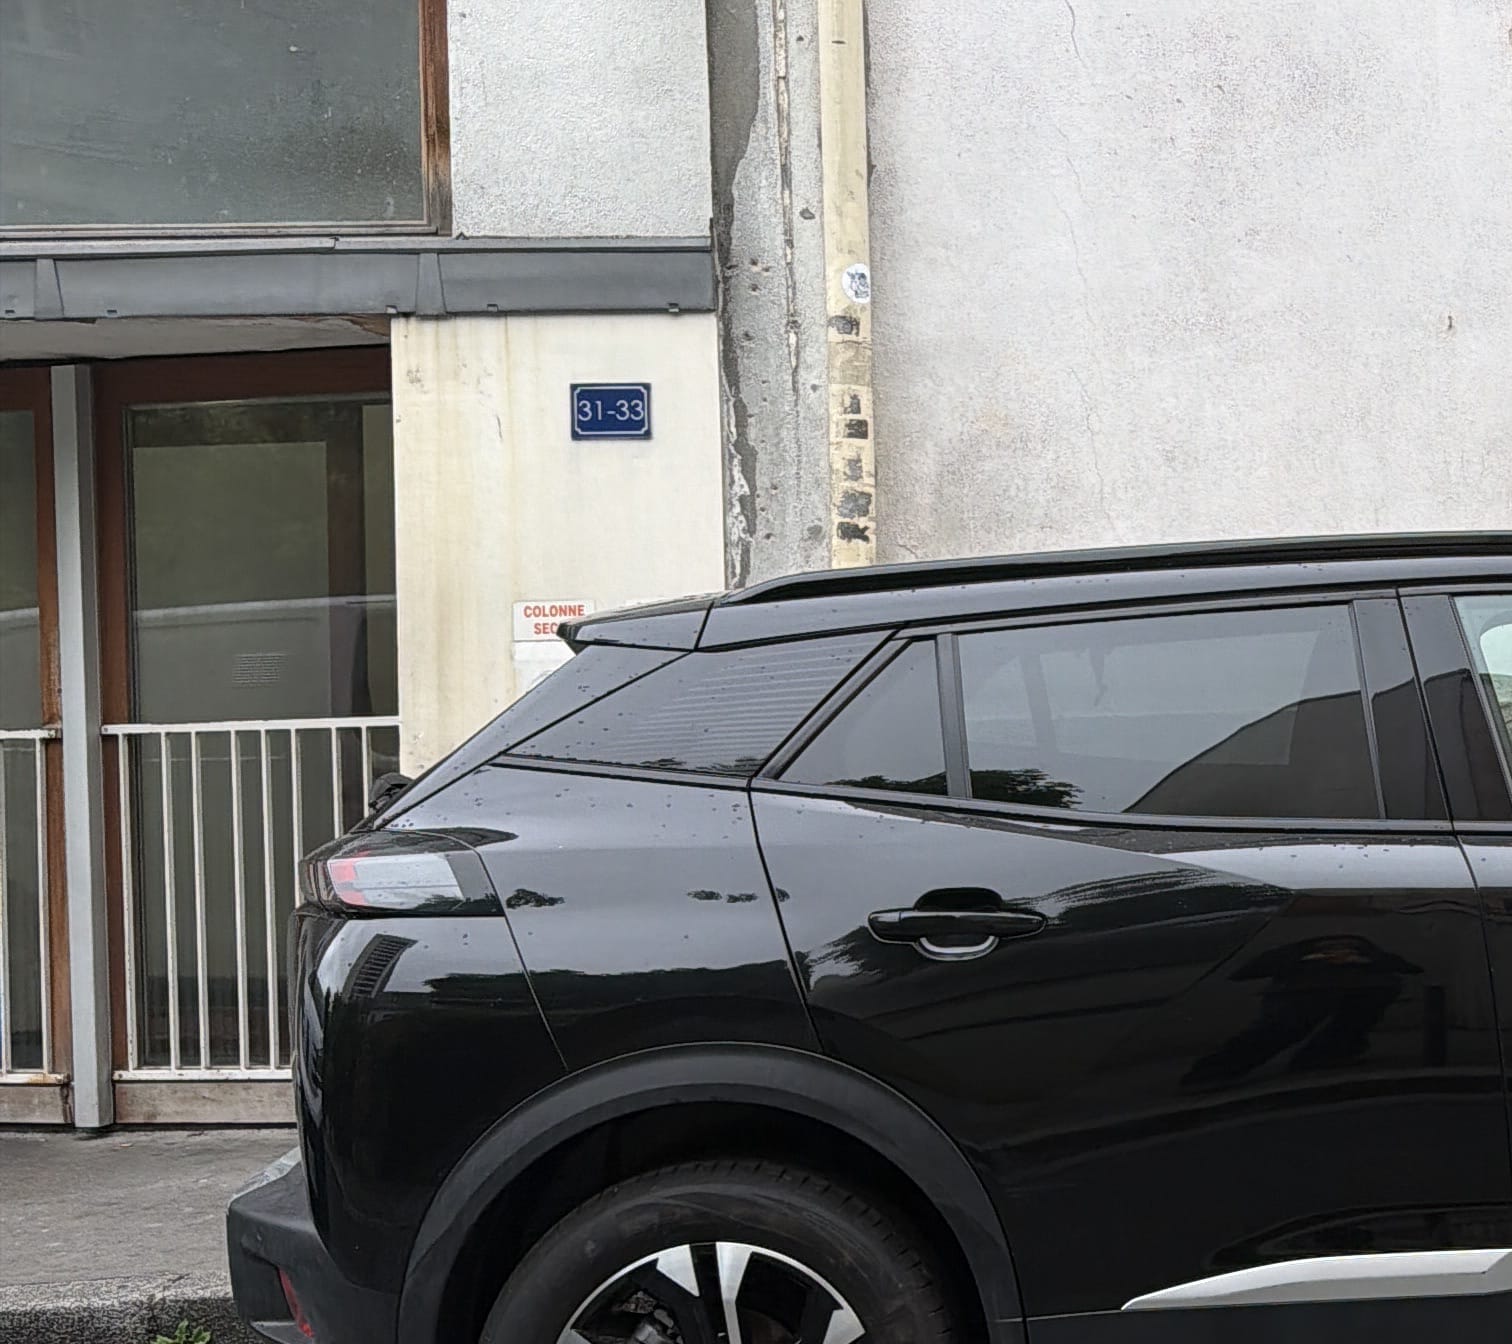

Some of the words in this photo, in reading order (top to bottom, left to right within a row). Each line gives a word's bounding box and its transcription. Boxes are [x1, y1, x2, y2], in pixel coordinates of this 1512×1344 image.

[578, 399, 645, 421] 31-33
[523, 604, 585, 618] COLONNE
[533, 622, 559, 635] SEC
